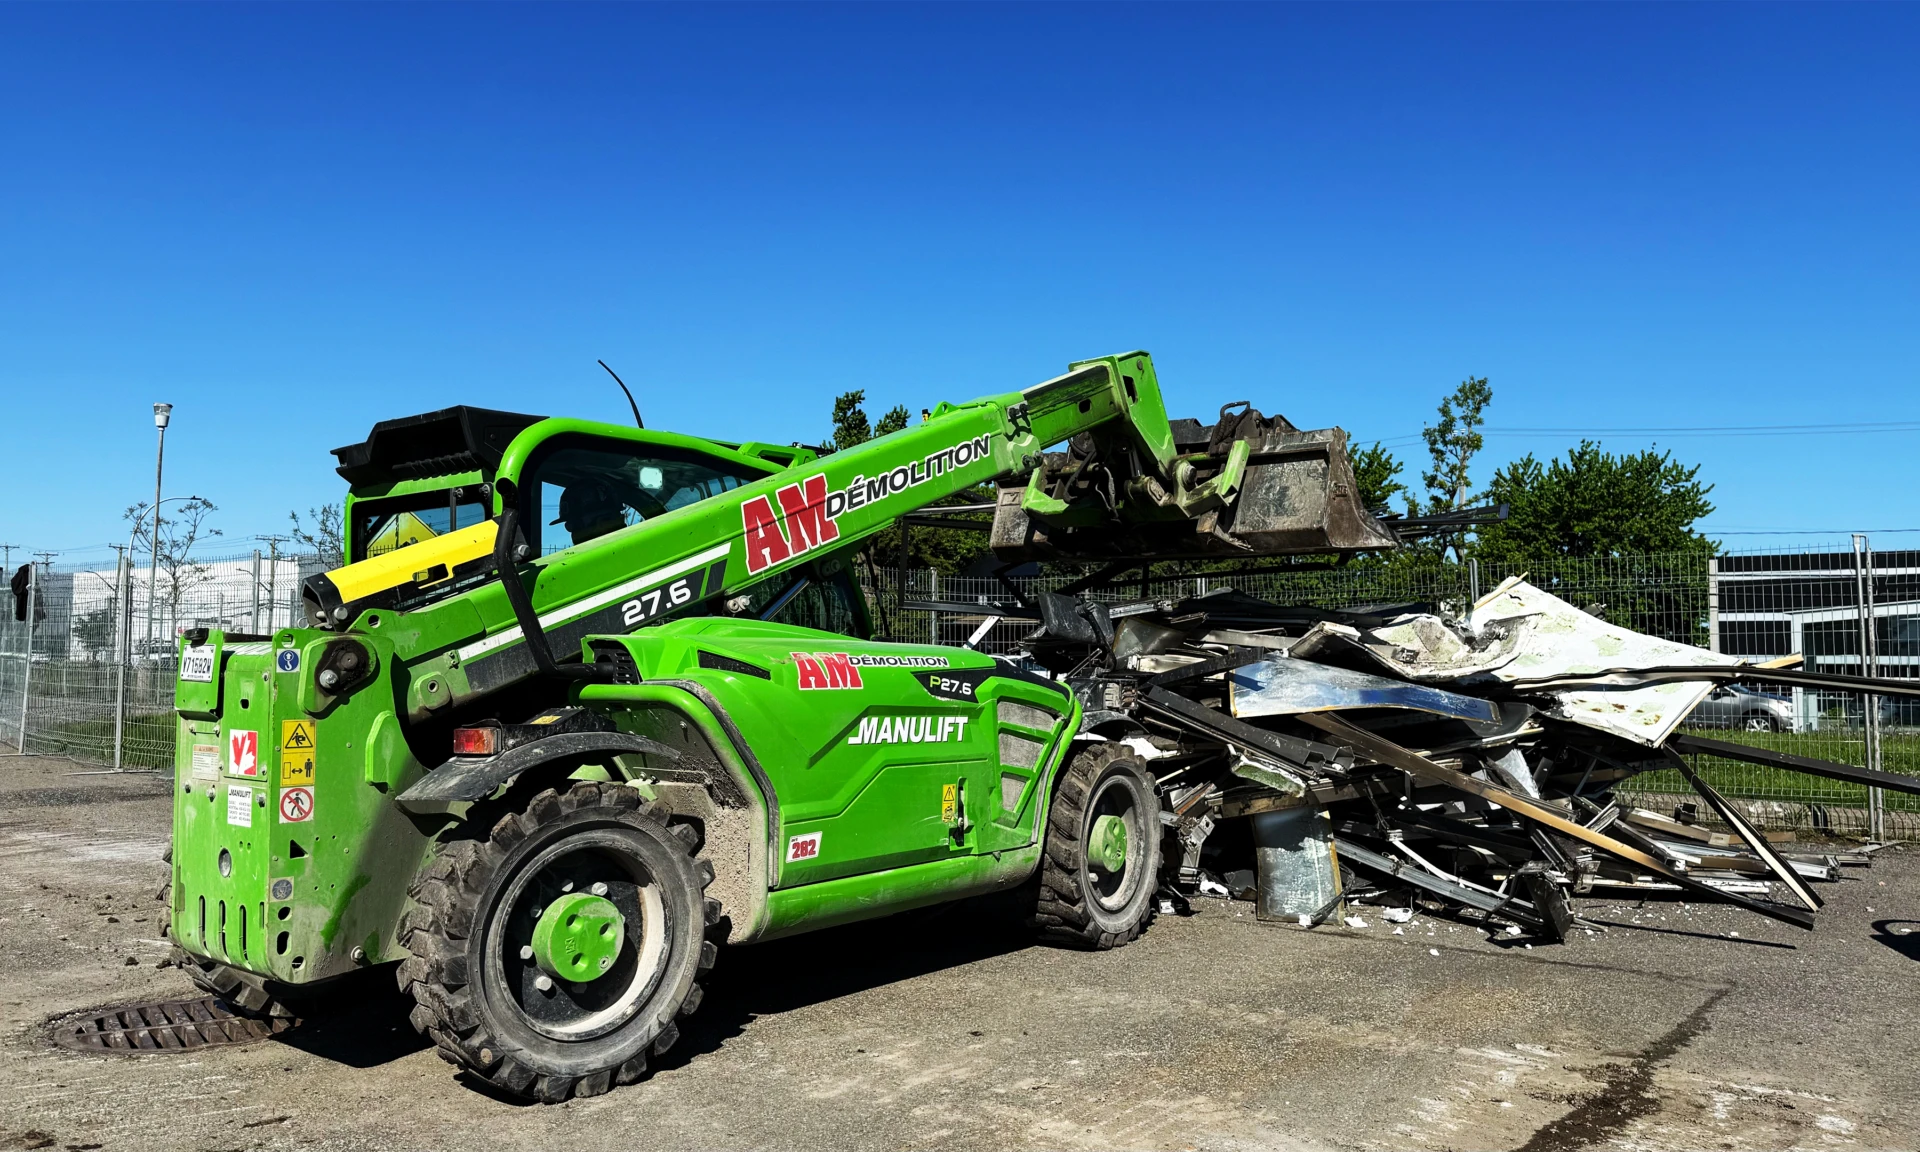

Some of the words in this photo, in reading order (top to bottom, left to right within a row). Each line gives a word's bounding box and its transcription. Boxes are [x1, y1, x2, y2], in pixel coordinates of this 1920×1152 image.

[742, 473, 839, 574] AM
[826, 435, 989, 518] DÉMOLITION
[622, 579, 691, 626] 27.6
[791, 652, 863, 690] AM
[850, 655, 948, 667] DÉMOLITION
[930, 675, 971, 695] P27.6
[848, 717, 968, 745] MANULIFT
[792, 839, 816, 859] 282
